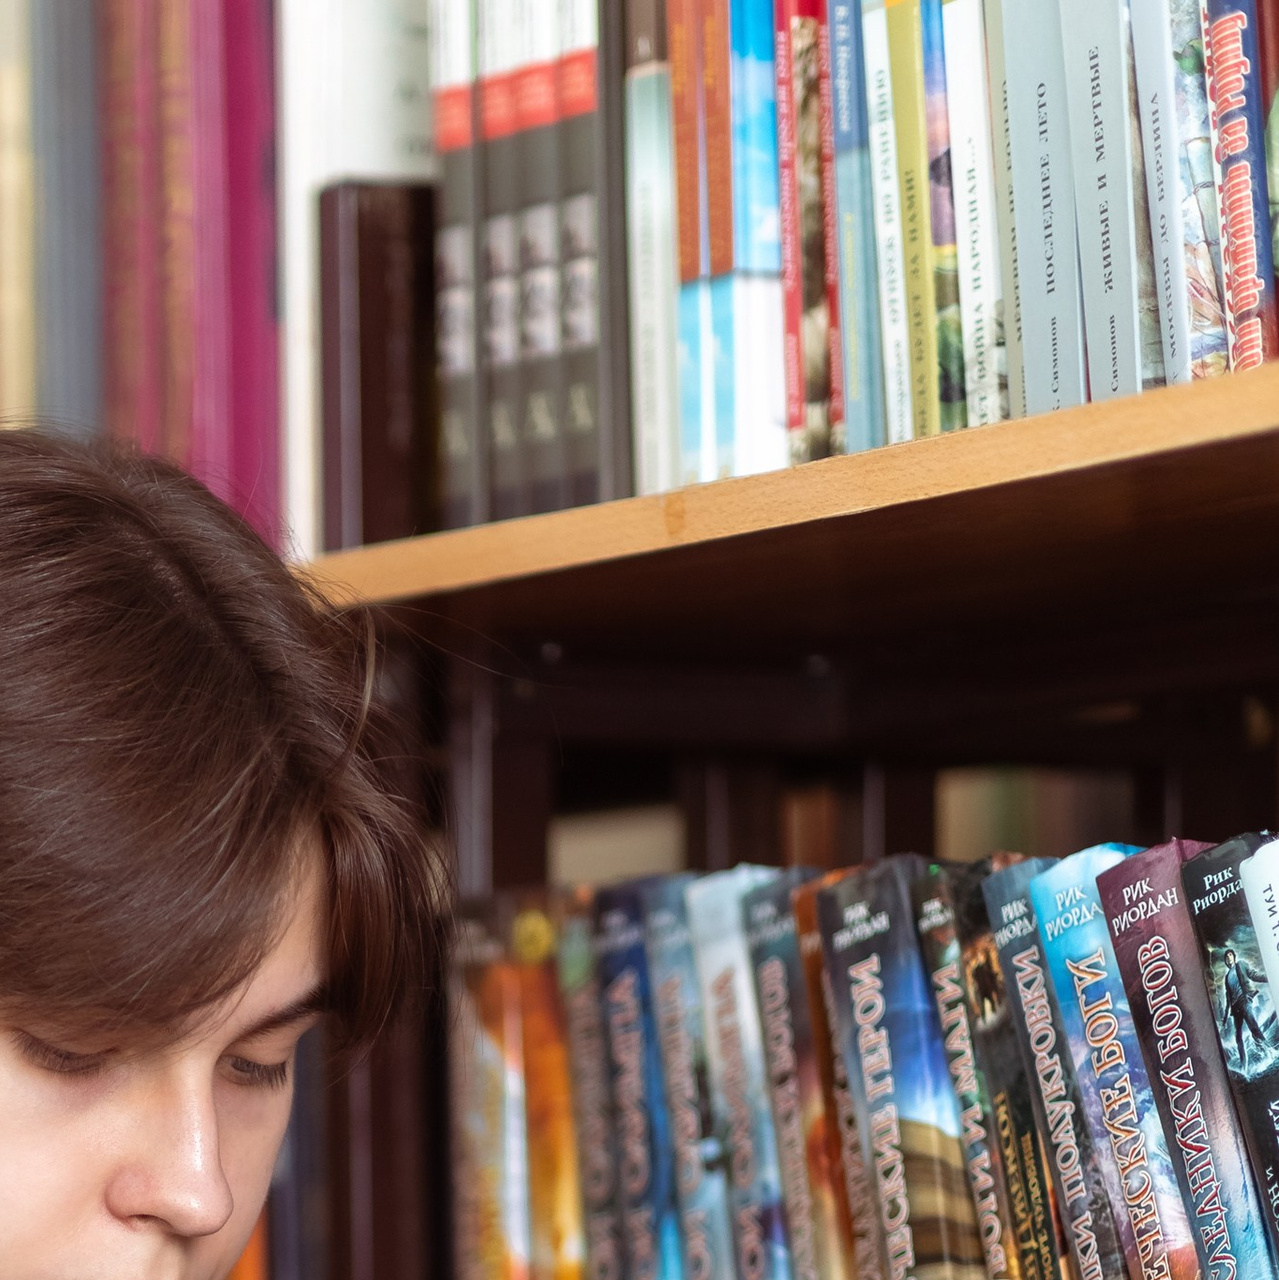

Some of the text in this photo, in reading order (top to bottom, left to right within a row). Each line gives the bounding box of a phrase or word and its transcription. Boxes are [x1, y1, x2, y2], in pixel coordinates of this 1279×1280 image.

[1036, 81, 1061, 395] Симонов ПОСЛЕДНЕЕ ЛЕТО
[1088, 46, 1121, 393] Симонов ЖИВЫЕ И МЕРТВЫЕ
[1150, 91, 1178, 360] МОСКВЫ ДО БЕРЛИНА
[972, 302, 988, 380] ВОЙНА
[1000, 898, 1030, 922] РИК
[1055, 883, 1088, 911] РИК
[1111, 887, 1180, 937] РИОРДАН
[1122, 877, 1154, 906] РИК
[1192, 879, 1244, 916] Риорда
[1203, 866, 1234, 891] Рик
[848, 953, 895, 1102] ГЕРОИ
[931, 962, 980, 1096] МАГИ
[1066, 946, 1126, 1079] БОГИ
[1137, 935, 1189, 1064] БОГОВ
[958, 1102, 988, 1147] И
[1012, 944, 1086, 1207] ПОЛУКРОВКИ
